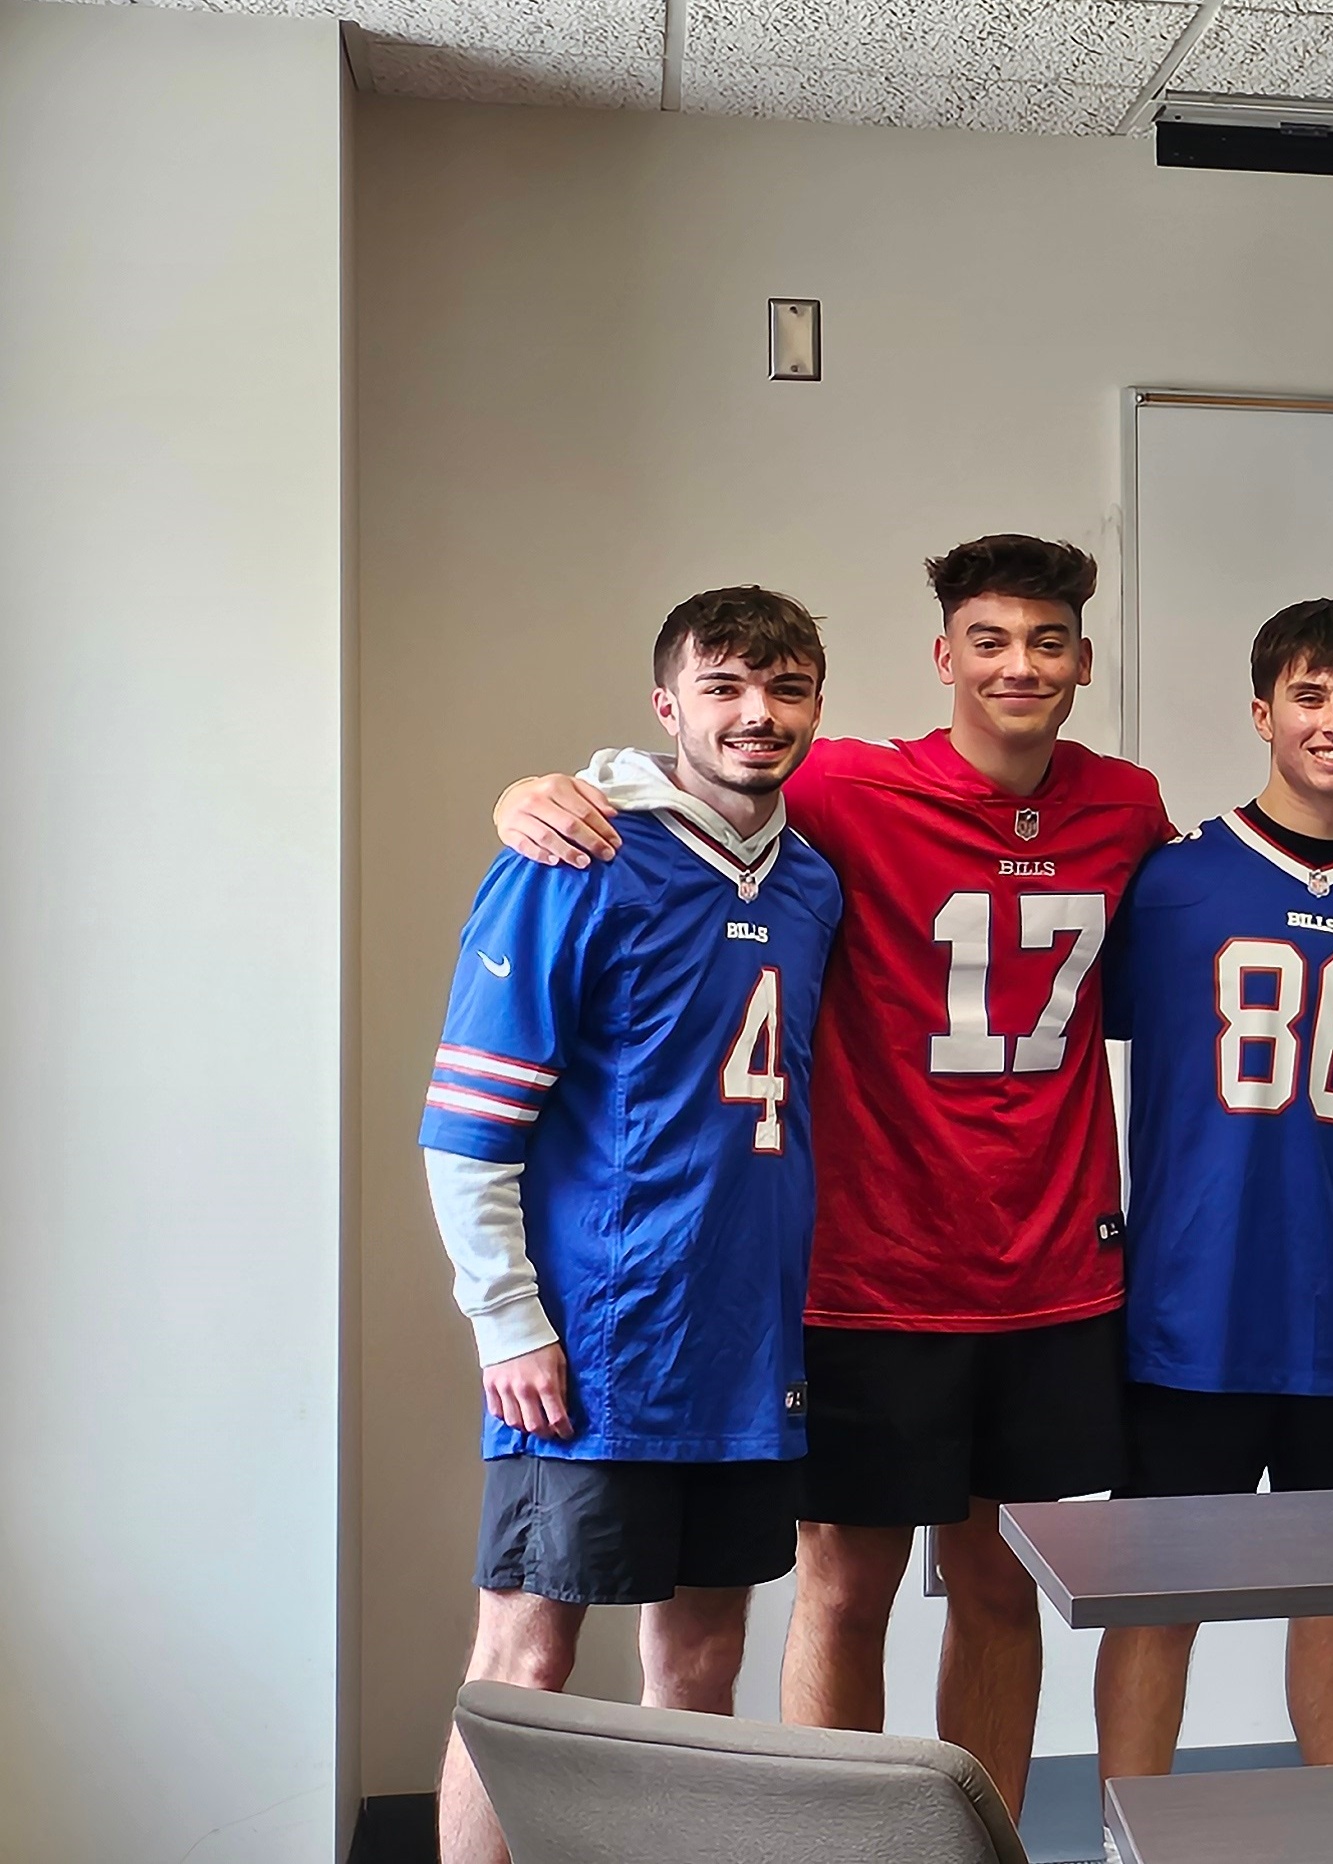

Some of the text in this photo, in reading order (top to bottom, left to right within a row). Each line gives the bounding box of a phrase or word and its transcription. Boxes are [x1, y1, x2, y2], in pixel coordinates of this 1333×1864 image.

[998, 859, 1056, 877] BILLS
[727, 922, 768, 943] BILLS
[929, 892, 1106, 1074] 17
[720, 967, 787, 1156] 4
